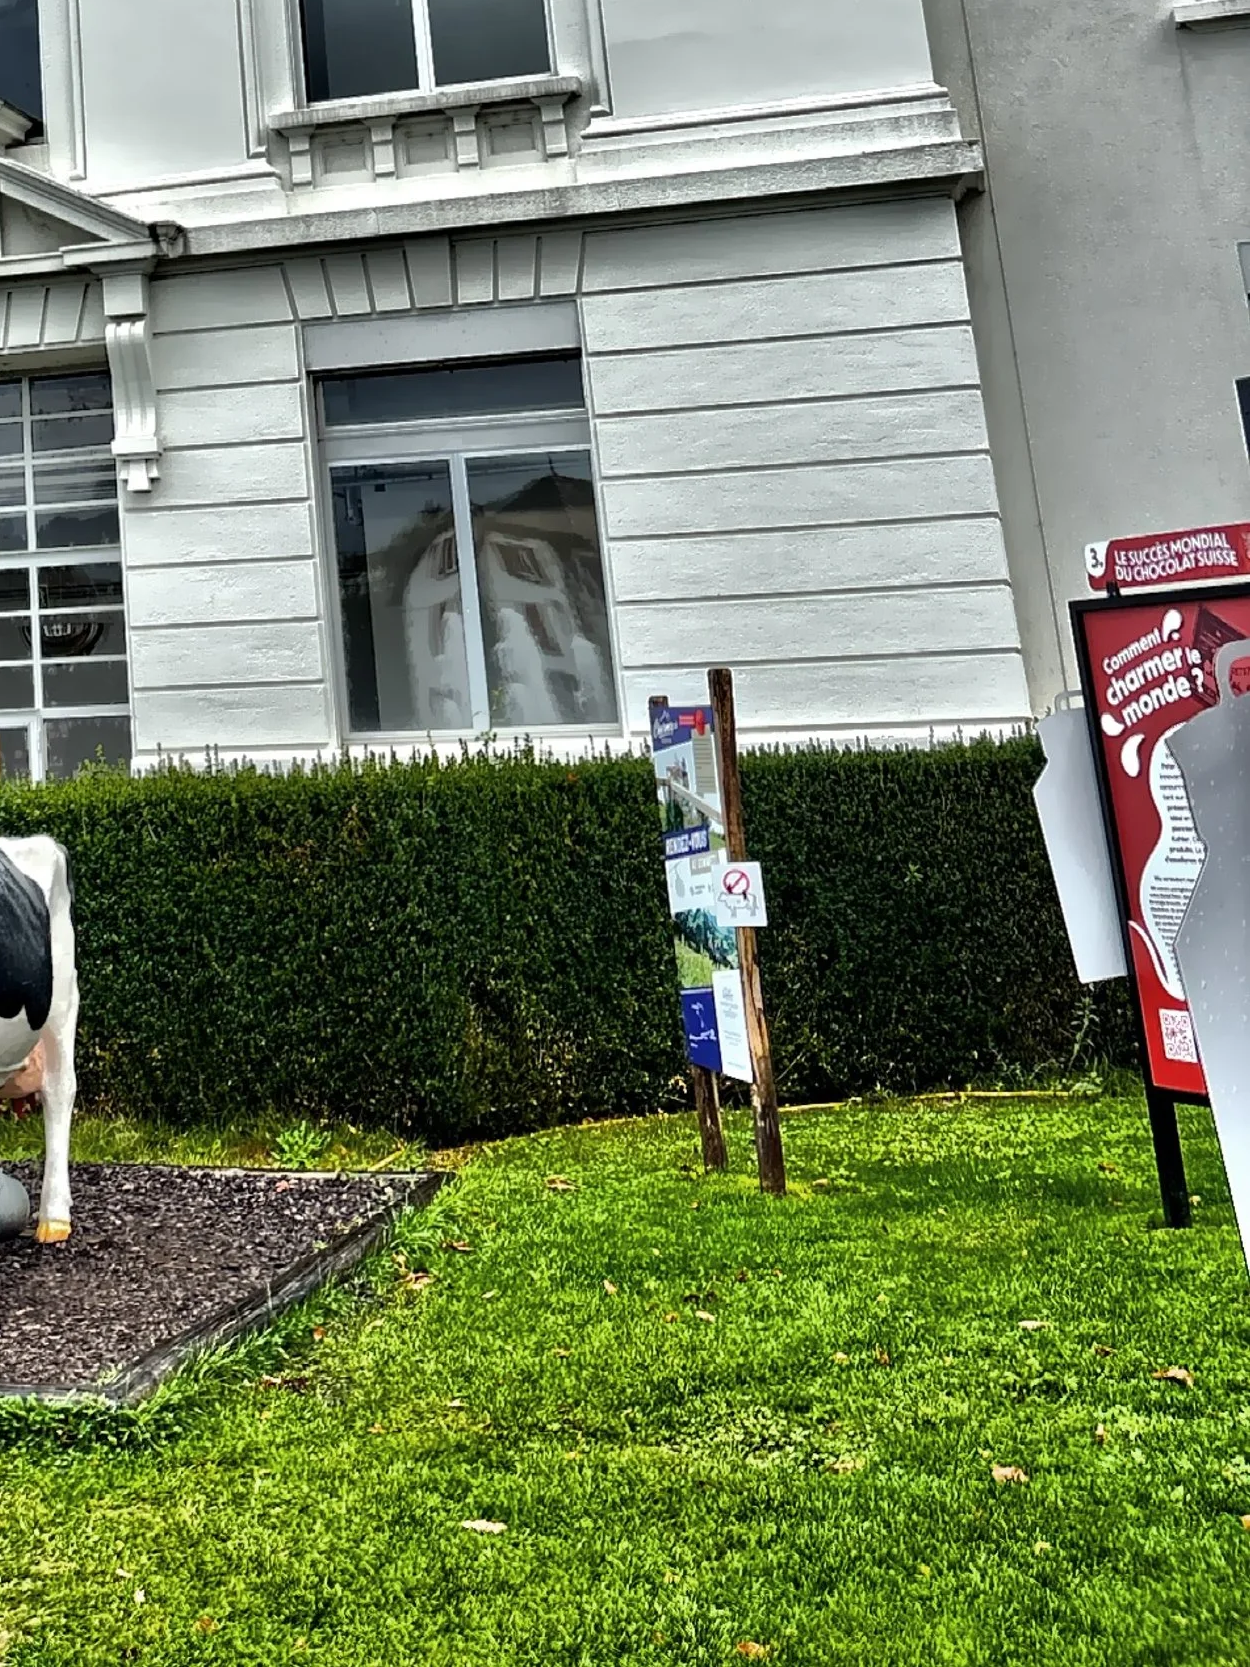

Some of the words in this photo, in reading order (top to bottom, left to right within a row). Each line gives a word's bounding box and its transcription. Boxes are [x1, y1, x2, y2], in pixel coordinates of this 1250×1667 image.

[1114, 550, 1127, 566] LE
[1127, 541, 1170, 566] SUCCÈS
[1170, 532, 1231, 555] MONDIAL
[1114, 565, 1132, 582] DU
[1133, 554, 1196, 581] CHOCOLAT
[1197, 548, 1239, 567] SUISSE
[1106, 646, 1183, 706] charmer
[1184, 646, 1202, 665] le
[1121, 674, 1192, 727] monde
[1191, 667, 1204, 693] ?
